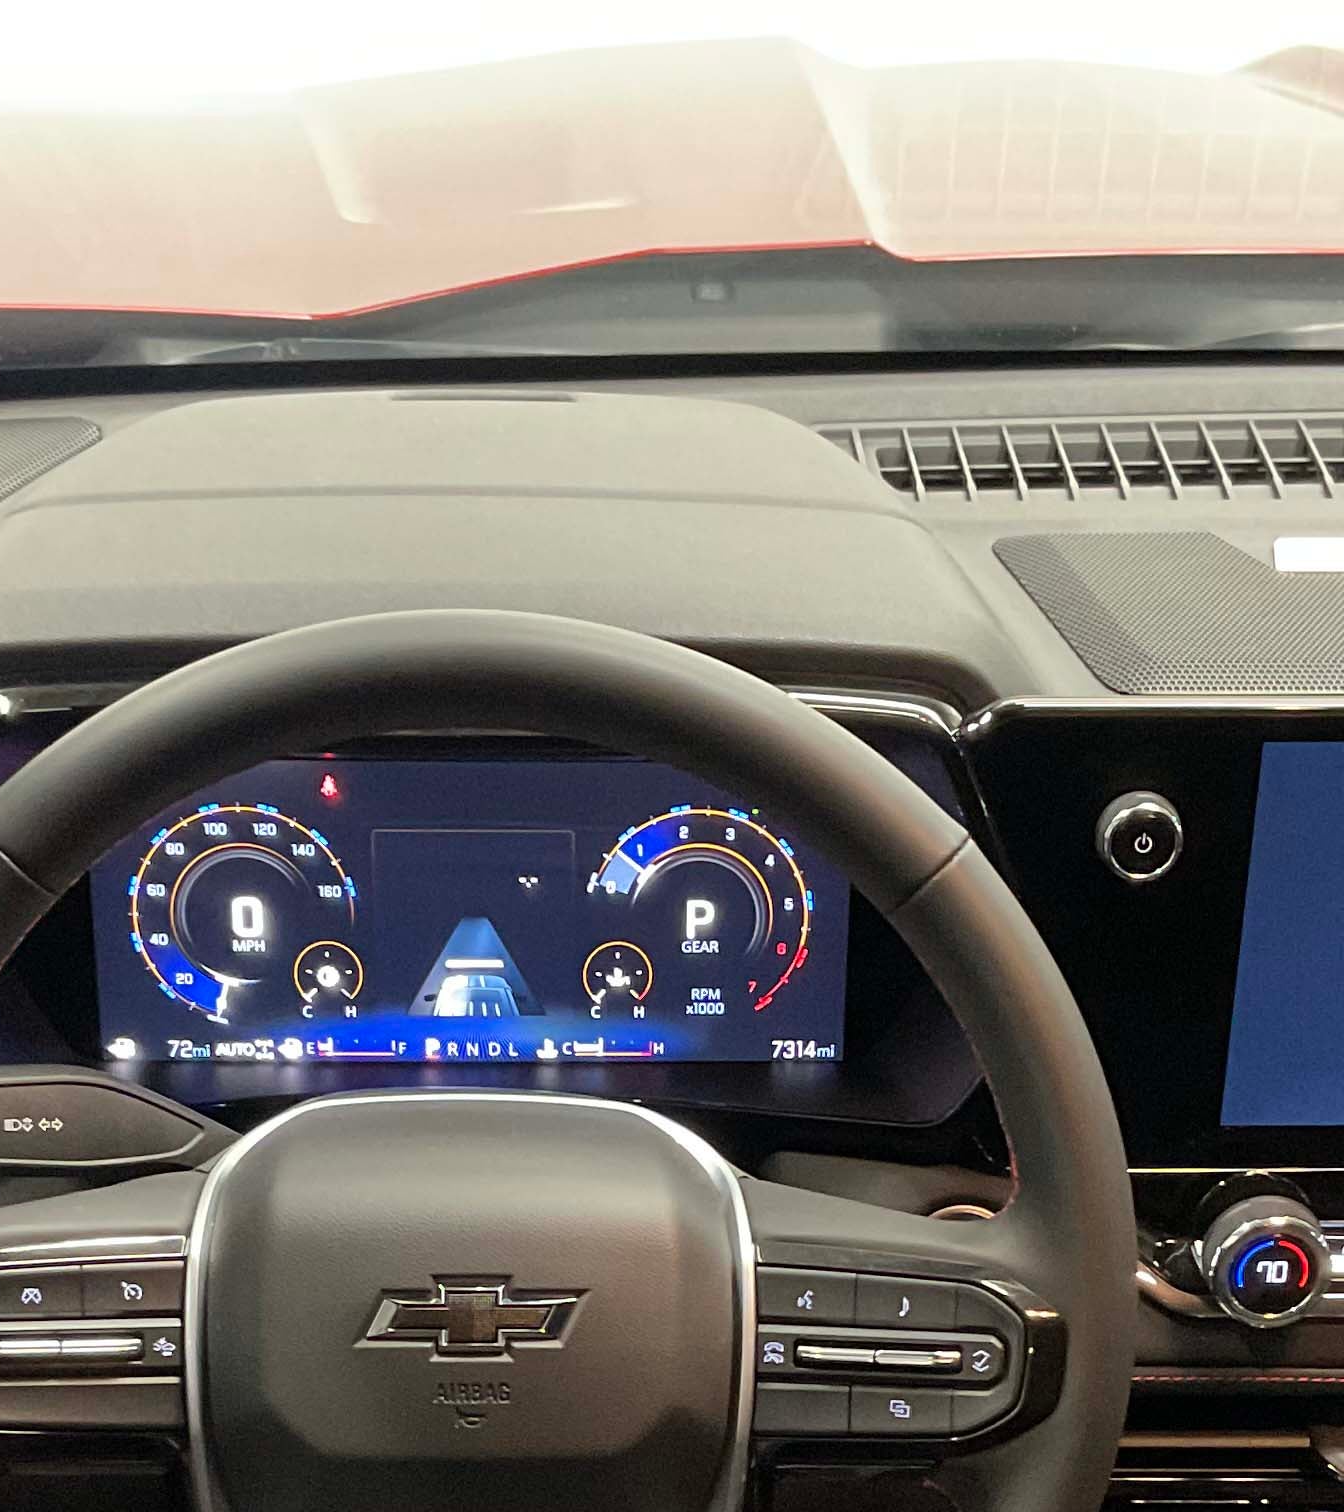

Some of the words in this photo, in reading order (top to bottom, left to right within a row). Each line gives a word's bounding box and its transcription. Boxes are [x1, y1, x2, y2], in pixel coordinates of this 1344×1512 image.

[203, 823, 227, 836] 100
[253, 823, 277, 836] 120
[679, 826, 689, 839] 2
[725, 828, 735, 840] 3
[166, 843, 184, 855] 80
[291, 844, 315, 856] 140
[637, 844, 643, 856] 1
[765, 854, 775, 867] 4
[146, 884, 165, 897] 60
[318, 885, 341, 897] 160
[784, 898, 794, 911] 5
[231, 897, 264, 937] 0
[686, 900, 715, 939] P
[150, 933, 169, 945] 40
[232, 940, 266, 952] MPH
[681, 941, 719, 953] GEAR
[777, 943, 786, 955] 6
[176, 973, 193, 984] 20
[748, 981, 756, 992] 7
[691, 988, 720, 1000] RPM
[302, 1005, 313, 1018] C
[345, 1005, 356, 1018] H
[590, 1005, 601, 1018] C
[633, 1005, 644, 1018] H
[686, 1003, 725, 1015] x1000
[216, 1042, 255, 1056] AUTO
[307, 1043, 314, 1054] E
[398, 1042, 406, 1054] F
[425, 1038, 440, 1055] P
[448, 1042, 458, 1056] R
[467, 1042, 478, 1056] N
[488, 1042, 500, 1056] D
[509, 1042, 518, 1056] L
[1256, 1260, 1288, 1284] 70
[432, 1383, 510, 1404] AIRBAG
